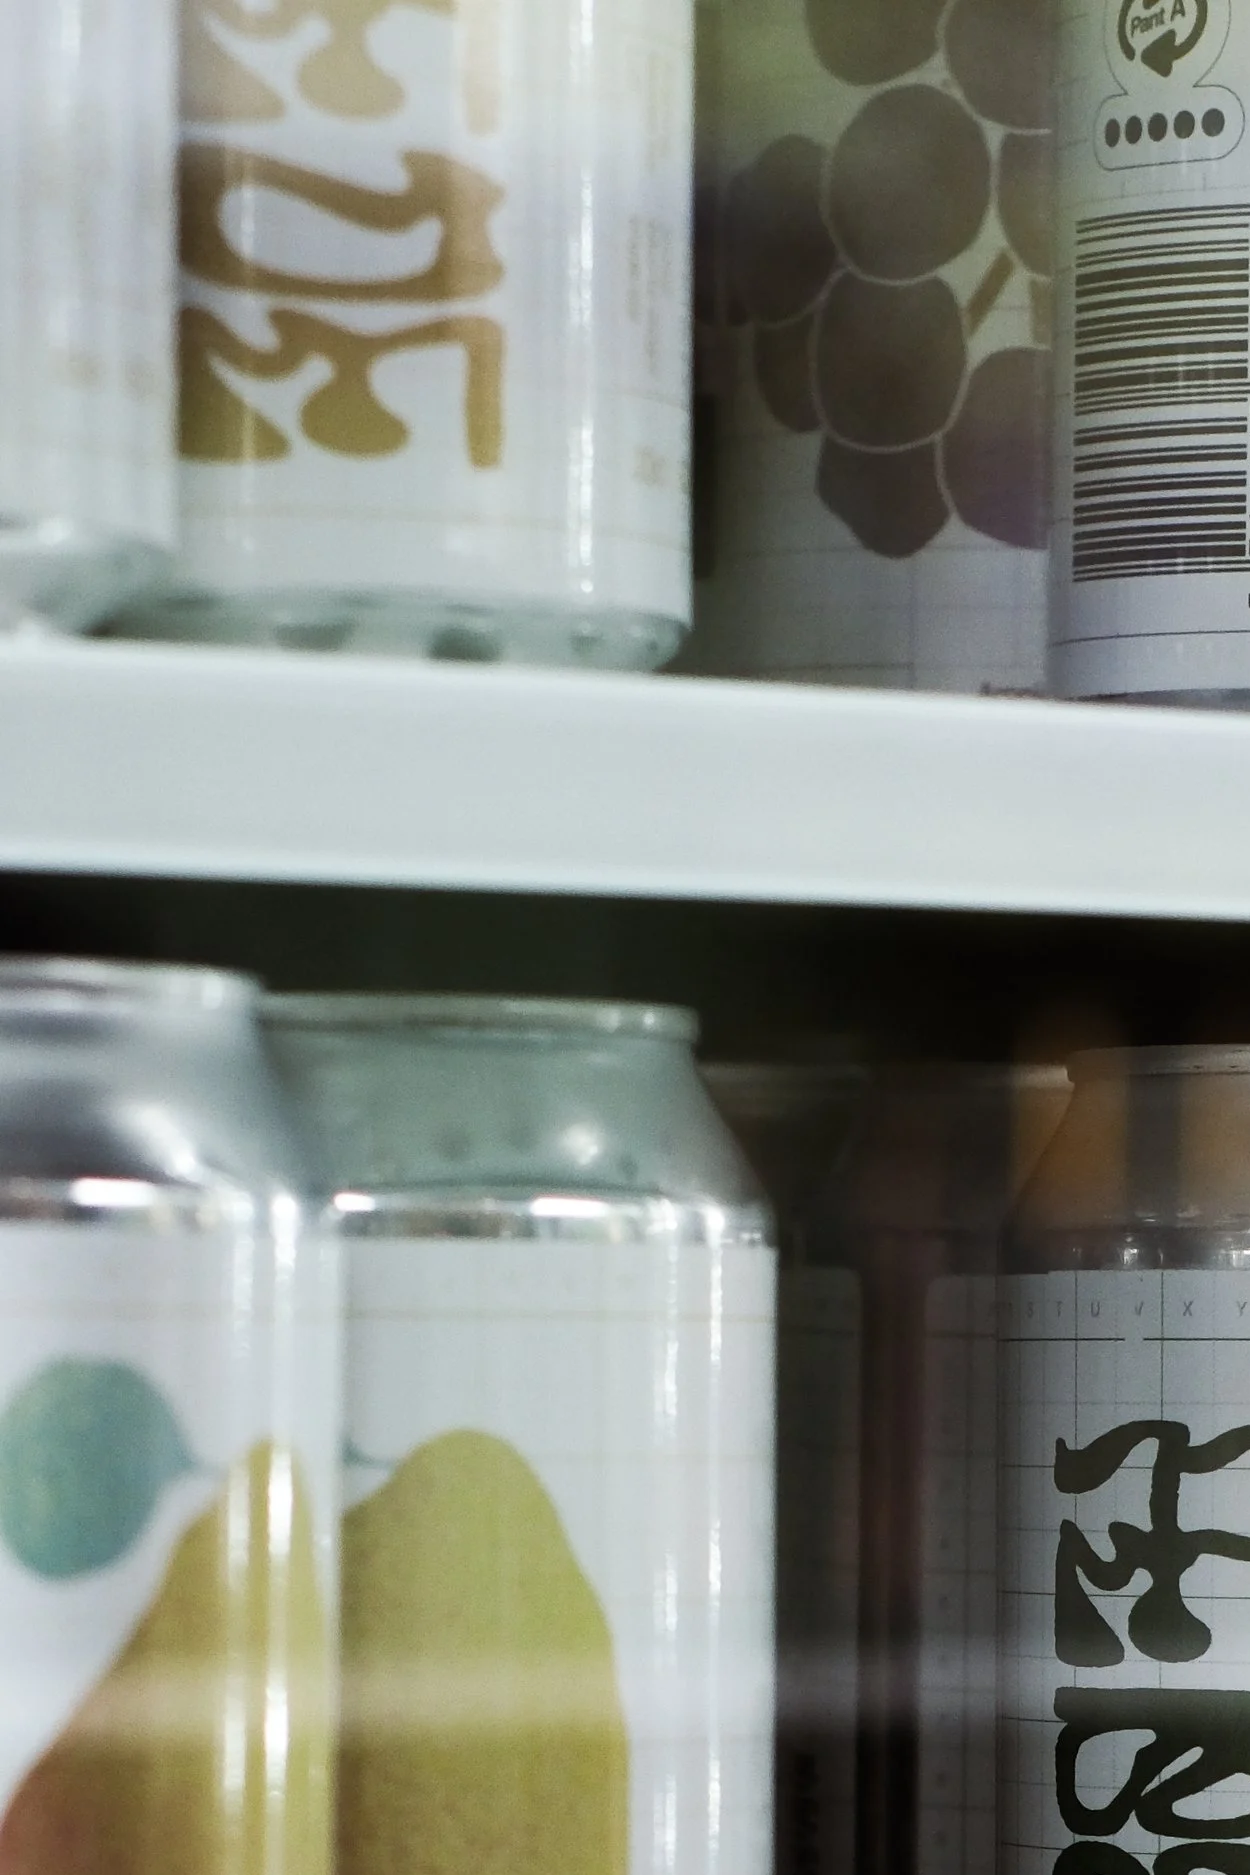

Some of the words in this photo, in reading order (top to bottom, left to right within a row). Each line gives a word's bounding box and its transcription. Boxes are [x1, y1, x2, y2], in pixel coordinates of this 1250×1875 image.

[1130, 8, 1165, 38] Pant
[1170, 0, 1186, 22] A
[1091, 1301, 1100, 1318] U
[1134, 1301, 1143, 1317] V
[1183, 1301, 1193, 1317] X
[1237, 1301, 1247, 1317] Y
